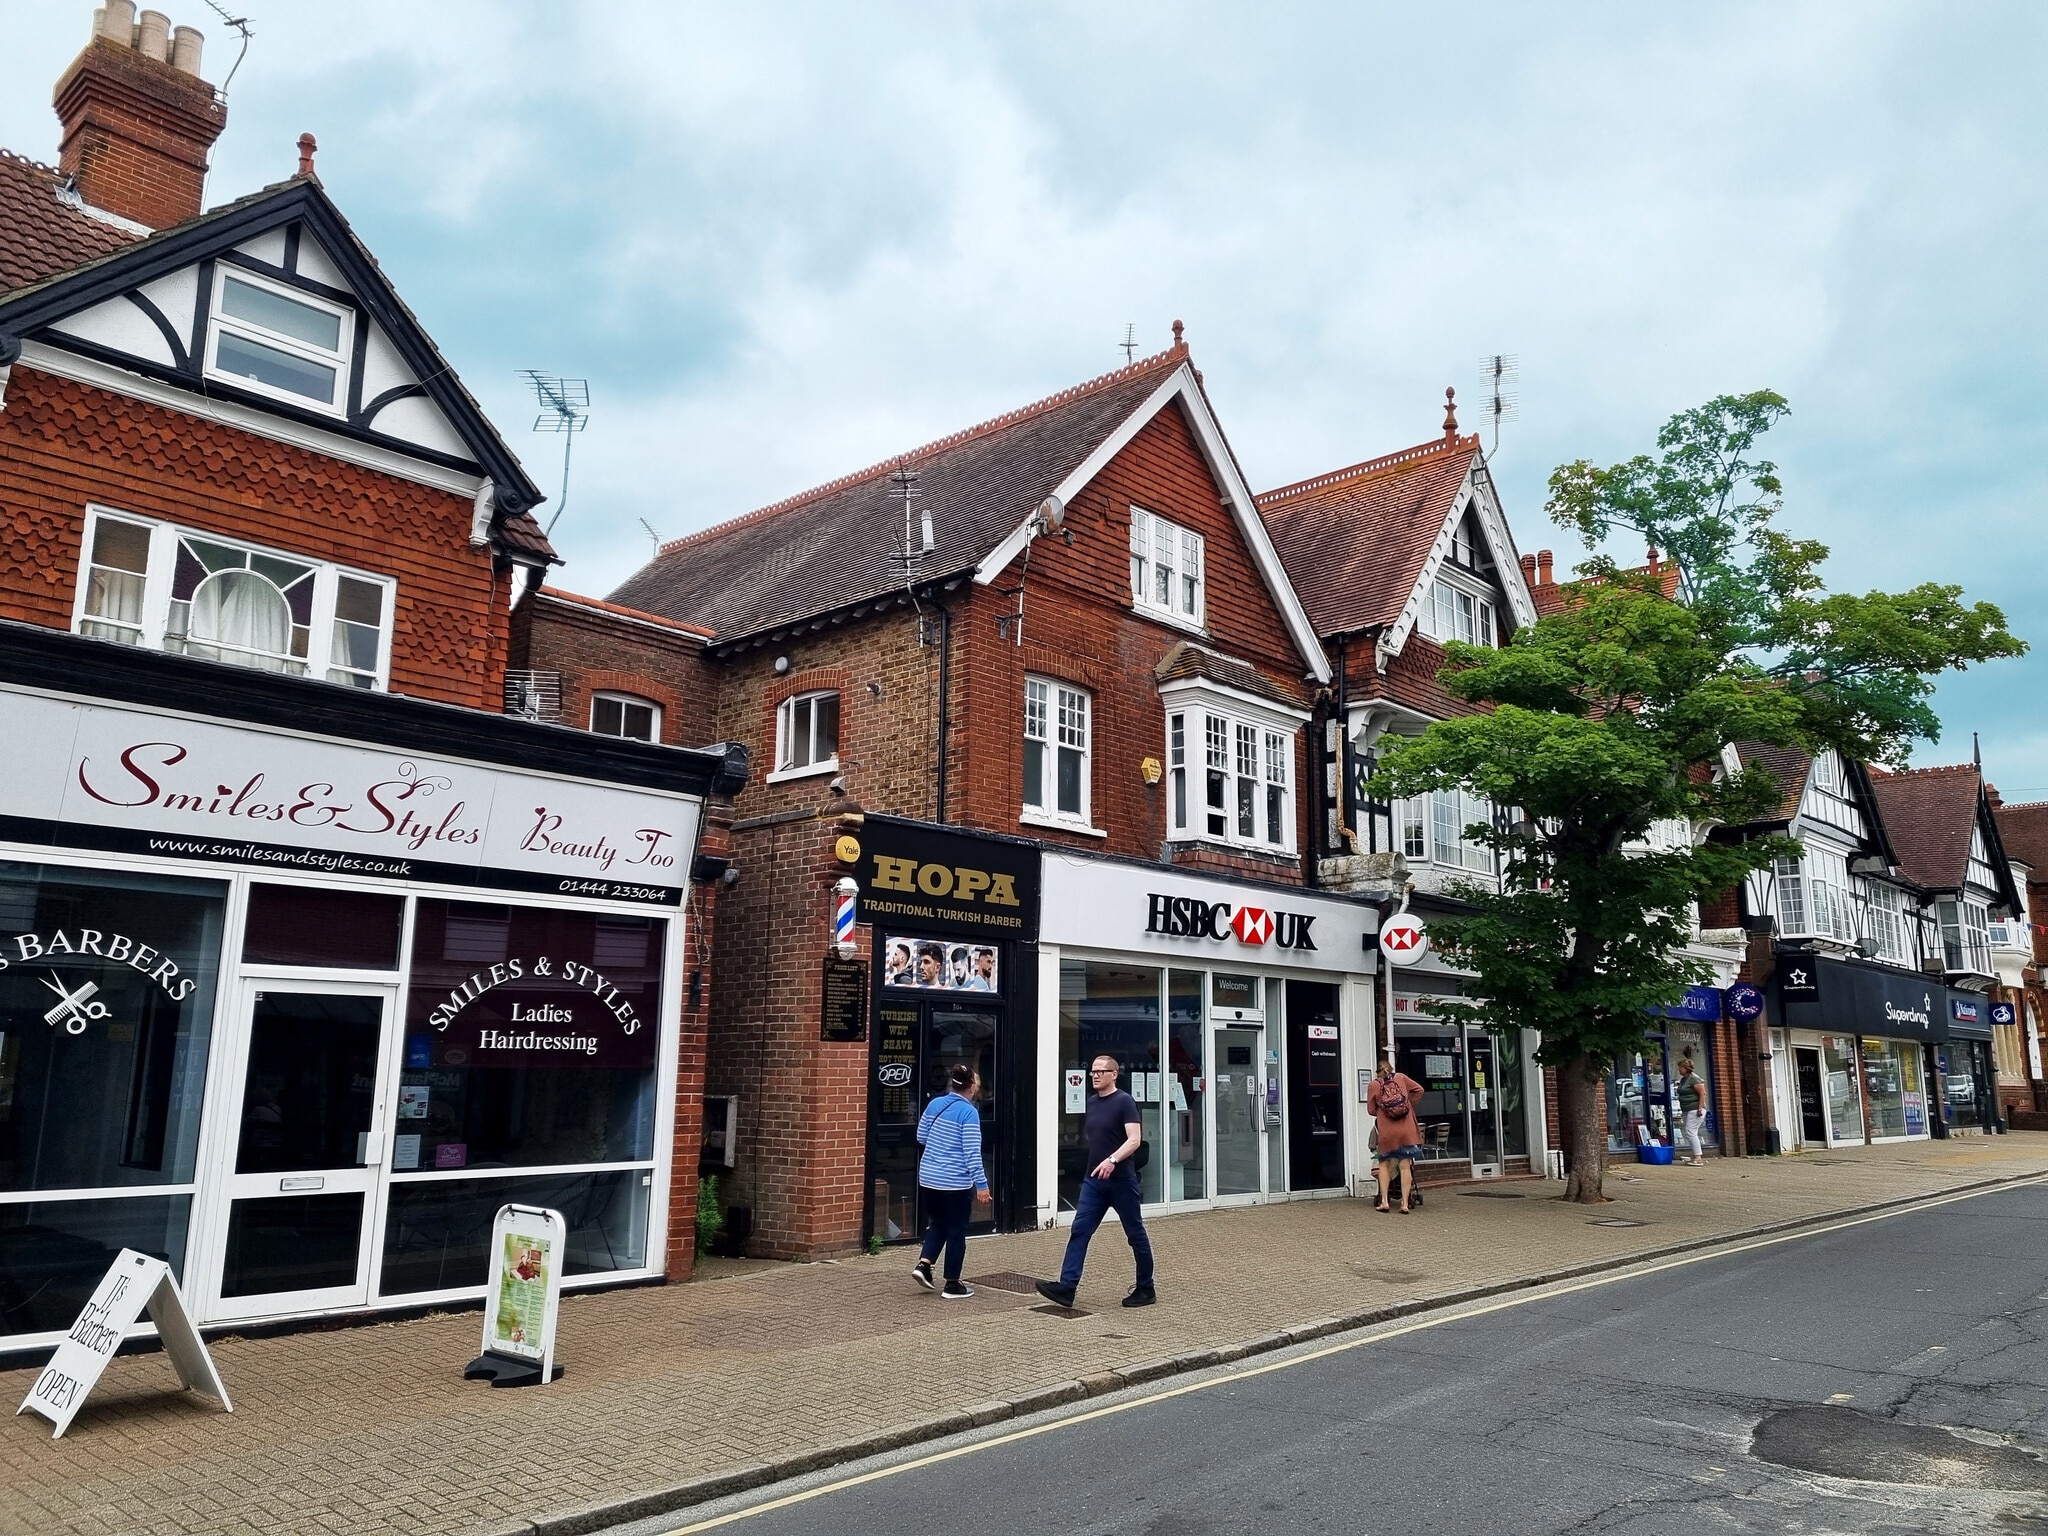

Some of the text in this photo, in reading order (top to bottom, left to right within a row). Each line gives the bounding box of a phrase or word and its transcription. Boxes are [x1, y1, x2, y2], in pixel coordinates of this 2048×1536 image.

[78, 742, 479, 851] Smiles & Styles
[520, 806, 674, 872] Beauty Too
[844, 845, 859, 856] Yale
[149, 838, 411, 875] www.smilesandstyles.co.uk
[559, 879, 666, 901] 01444 233064
[871, 854, 1020, 907] HOPA
[863, 899, 1022, 928] TRADITIONAL TURKISH BARBER
[1144, 893, 1319, 951] HSBC UK
[13, 928, 197, 1001] BARBERS
[429, 956, 642, 1035] SMILES & STYLES
[1218, 979, 1249, 992] Welcome
[510, 1003, 573, 1023] Ladies
[879, 1010, 918, 1022] TURKISH
[1395, 999, 1409, 1013] HOT
[1885, 1001, 1929, 1030] Superdrug
[478, 1030, 598, 1055] Hairdressing
[883, 1039, 913, 1050] SHAVE
[888, 1025, 909, 1036] WET
[878, 1068, 912, 1082] OPEN
[68, 1302, 119, 1355] Barbers
[35, 1368, 84, 1411] OPEN
